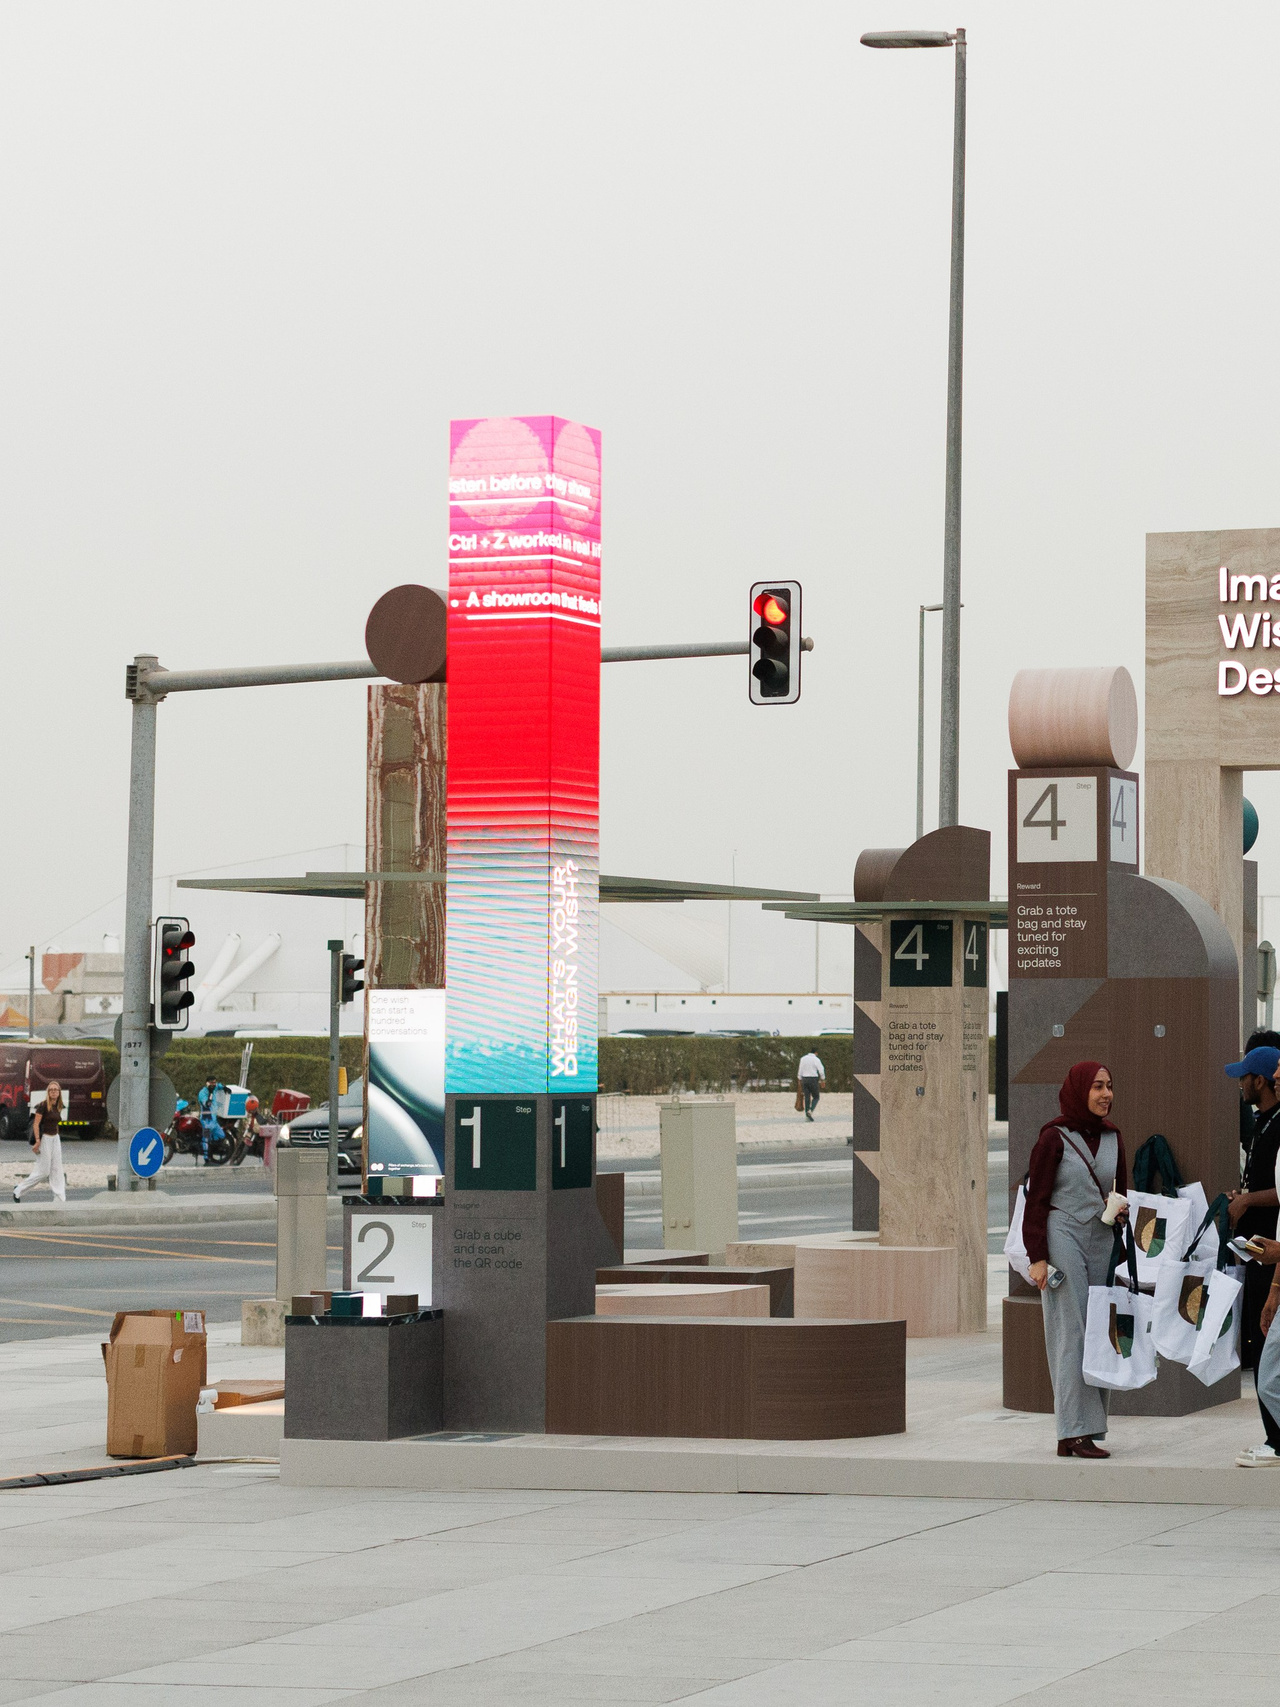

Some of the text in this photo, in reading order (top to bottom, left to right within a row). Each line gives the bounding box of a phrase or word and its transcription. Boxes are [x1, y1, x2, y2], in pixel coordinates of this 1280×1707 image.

[490, 474, 542, 491] before
[545, 474, 567, 496] they
[449, 534, 477, 550] Ctrl
[480, 537, 490, 548] +
[493, 532, 506, 549] Z
[508, 531, 562, 549] worked
[563, 534, 572, 551] in
[573, 540, 590, 556] real
[466, 591, 480, 608] A
[482, 591, 561, 608] showroom
[1022, 783, 1067, 841] 4
[1112, 785, 1127, 842] 4
[1017, 905, 1078, 916] Grab a tote
[1017, 919, 1087, 931] bag and stay
[1017, 932, 1067, 942] tuned for
[894, 924, 930, 971] 4
[965, 924, 979, 971] 4
[1017, 945, 1059, 957] exciting
[564, 859, 579, 1076] DESIGN WISH?
[1017, 958, 1062, 970] updates
[551, 866, 567, 1077] WHAT'S YOUR
[371, 995, 388, 1004] One
[391, 996, 409, 1004] wish
[371, 1007, 386, 1015] can
[388, 1007, 407, 1015] start
[371, 1016, 406, 1025] hundred
[889, 1021, 910, 1030] Grab
[920, 1021, 937, 1030] tote
[371, 1027, 428, 1035] conversations
[889, 1032, 944, 1042] bag and stay
[889, 1043, 928, 1051] tuned for
[889, 1053, 922, 1062] exciting
[889, 1063, 924, 1072] updates
[460, 1106, 532, 1169] 1 Step
[554, 1105, 566, 1168] 1
[453, 1202, 480, 1210] Imagine
[454, 1229, 522, 1241] Grab a cube
[357, 1221, 427, 1283] 2 Step
[453, 1244, 505, 1255] and scan
[453, 1258, 523, 1269] the QR code
